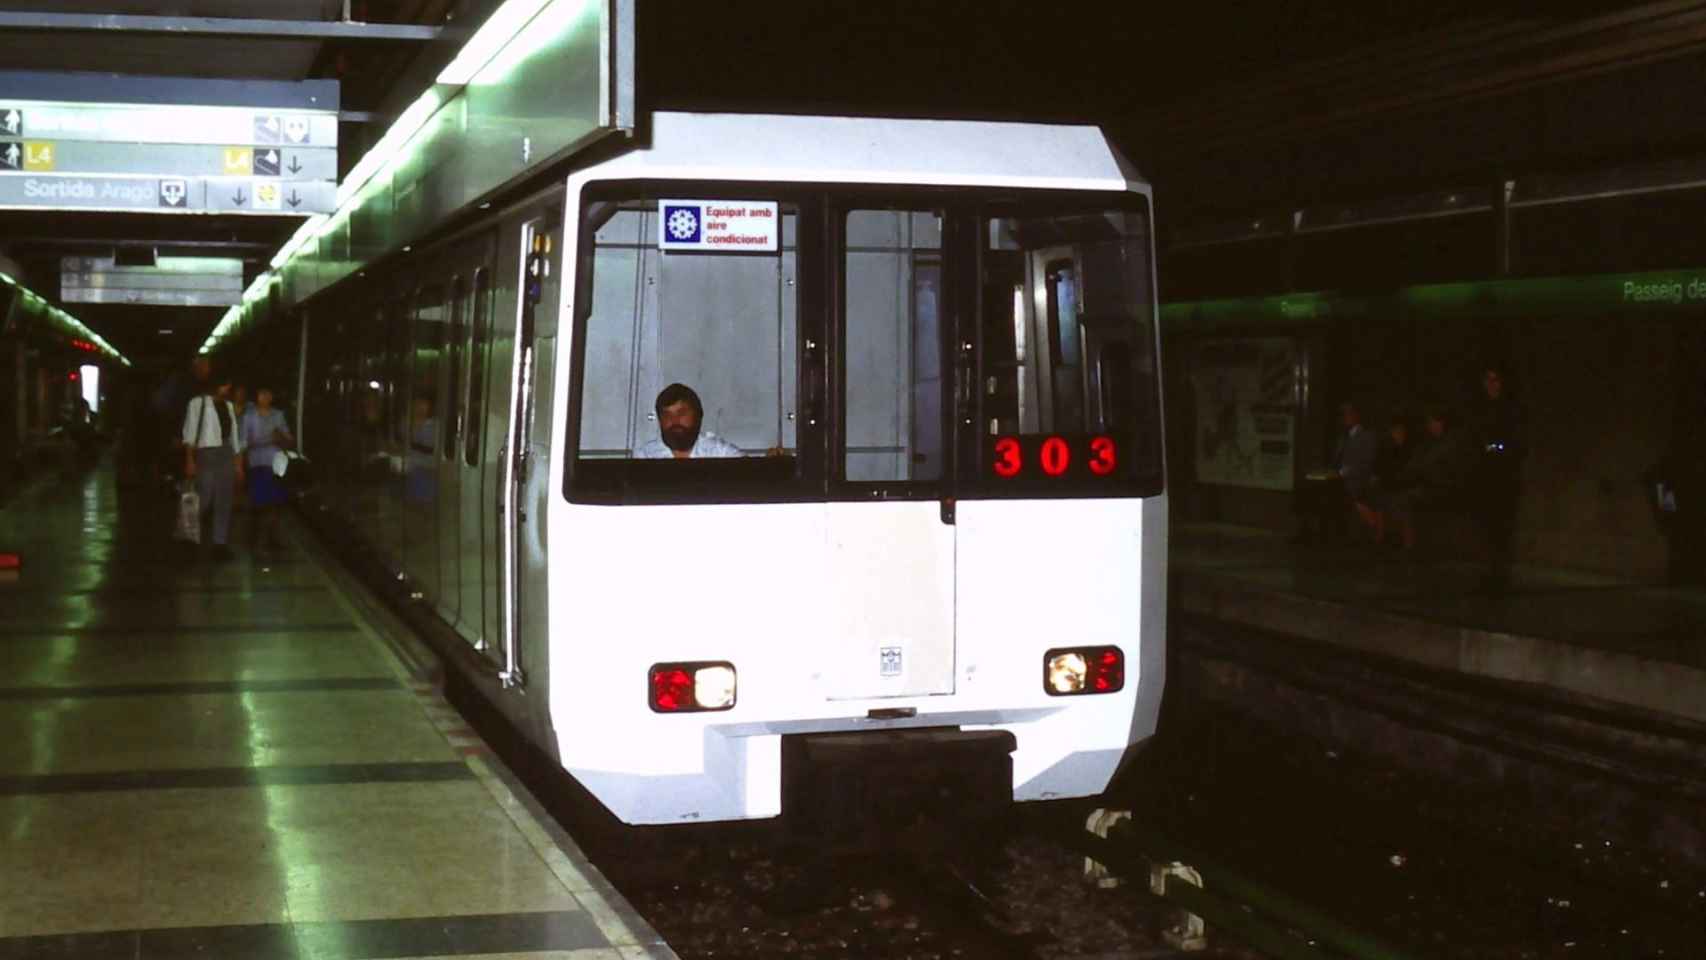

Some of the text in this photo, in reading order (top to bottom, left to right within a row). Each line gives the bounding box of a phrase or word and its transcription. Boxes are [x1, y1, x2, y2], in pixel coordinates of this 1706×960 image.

[27, 144, 51, 163] L4
[24, 178, 95, 198] Sortida
[706, 207, 773, 218] Equipat amb
[706, 220, 727, 230] aire
[706, 234, 768, 245] condicionat
[1623, 281, 1682, 304] Passeig
[993, 435, 1118, 478] 303
